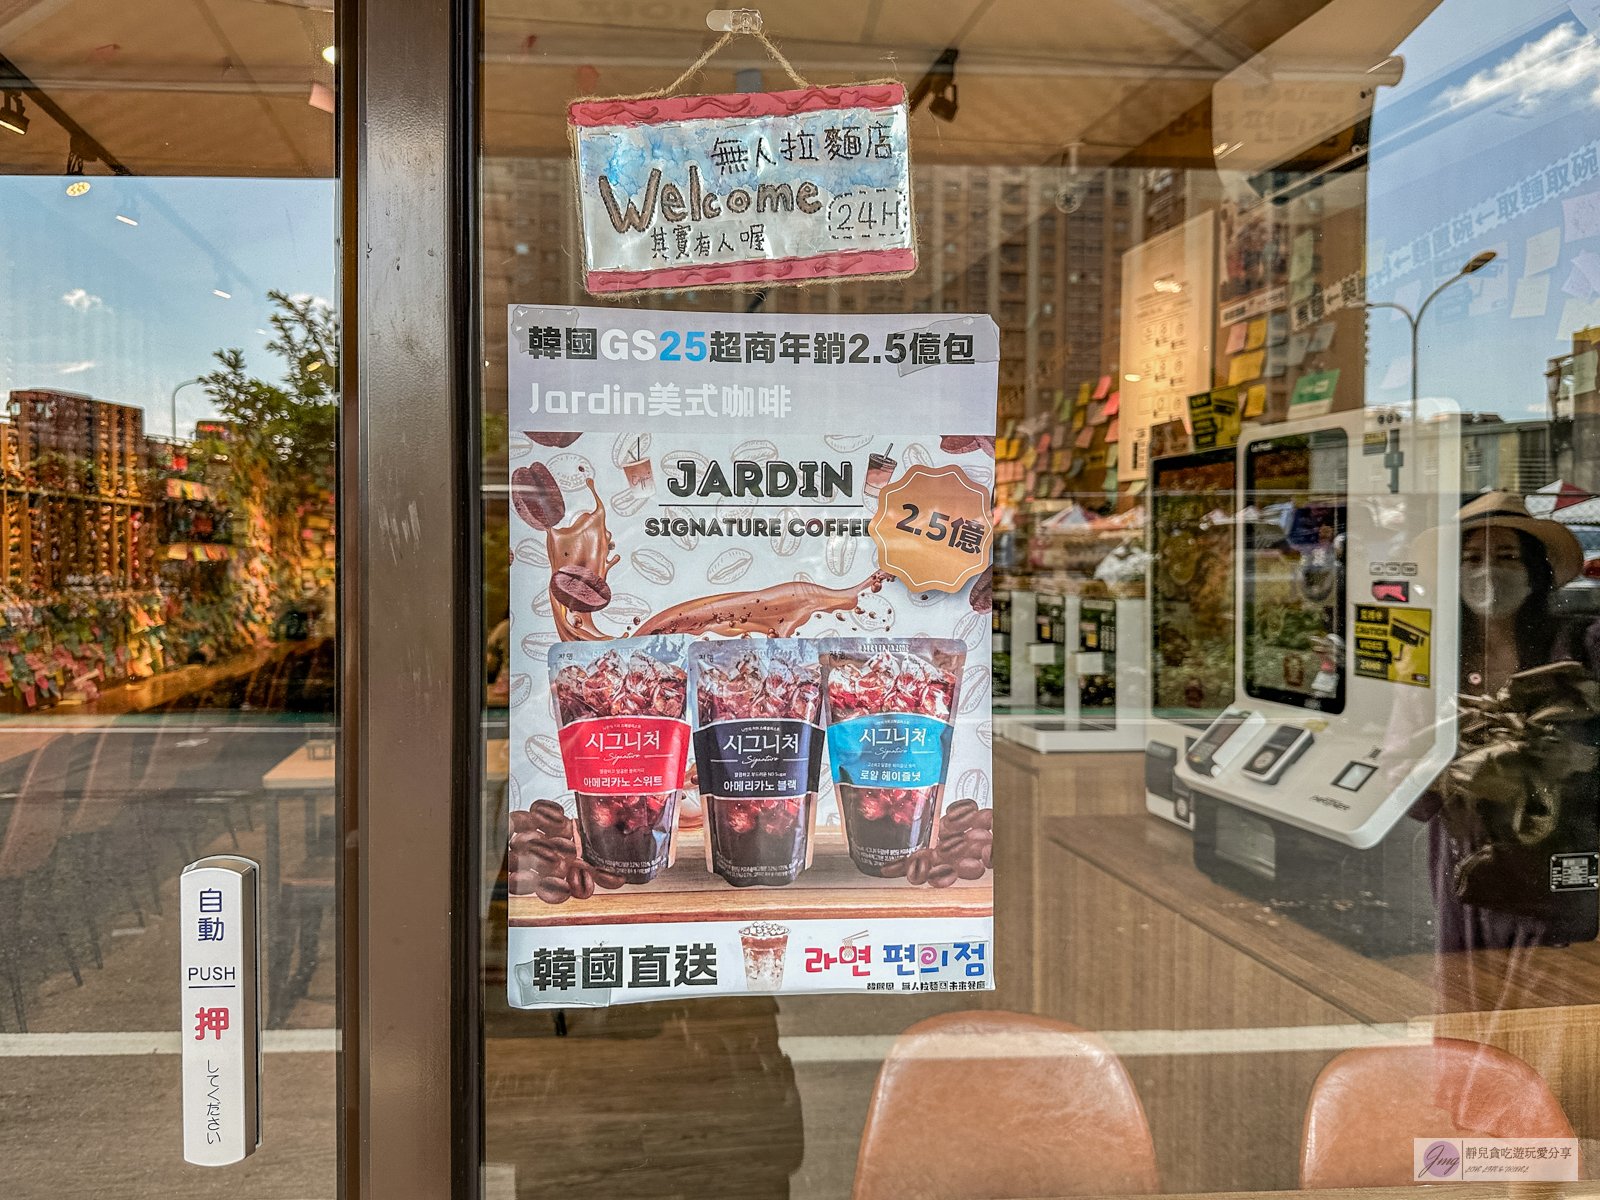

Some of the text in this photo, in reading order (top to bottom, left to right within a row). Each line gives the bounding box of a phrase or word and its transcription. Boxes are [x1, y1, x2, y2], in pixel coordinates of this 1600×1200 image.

[711, 120, 893, 175] 無人拉麵店
[599, 166, 823, 233] Welcome
[836, 200, 901, 231] 24H
[651, 223, 765, 260] 其實有人喔
[528, 325, 976, 366] 韓國GS25超商年銷2.5億包
[529, 382, 793, 419] Jardin美式咖啡
[667, 459, 853, 498] JARDIN
[645, 517, 782, 537] SIGNATURE
[895, 503, 985, 554] 2.5億
[585, 730, 660, 752] 시그니처
[723, 733, 799, 754] 시그니처
[859, 728, 927, 747] 시그니처
[583, 775, 663, 788] 아메리카노 스위트
[723, 779, 775, 792] 아메리카노
[197, 887, 225, 942] 自動
[188, 966, 236, 982] PUSH
[532, 943, 718, 991] 韓國直送
[195, 1006, 230, 1041] 押
[206, 1059, 222, 1145] してください
